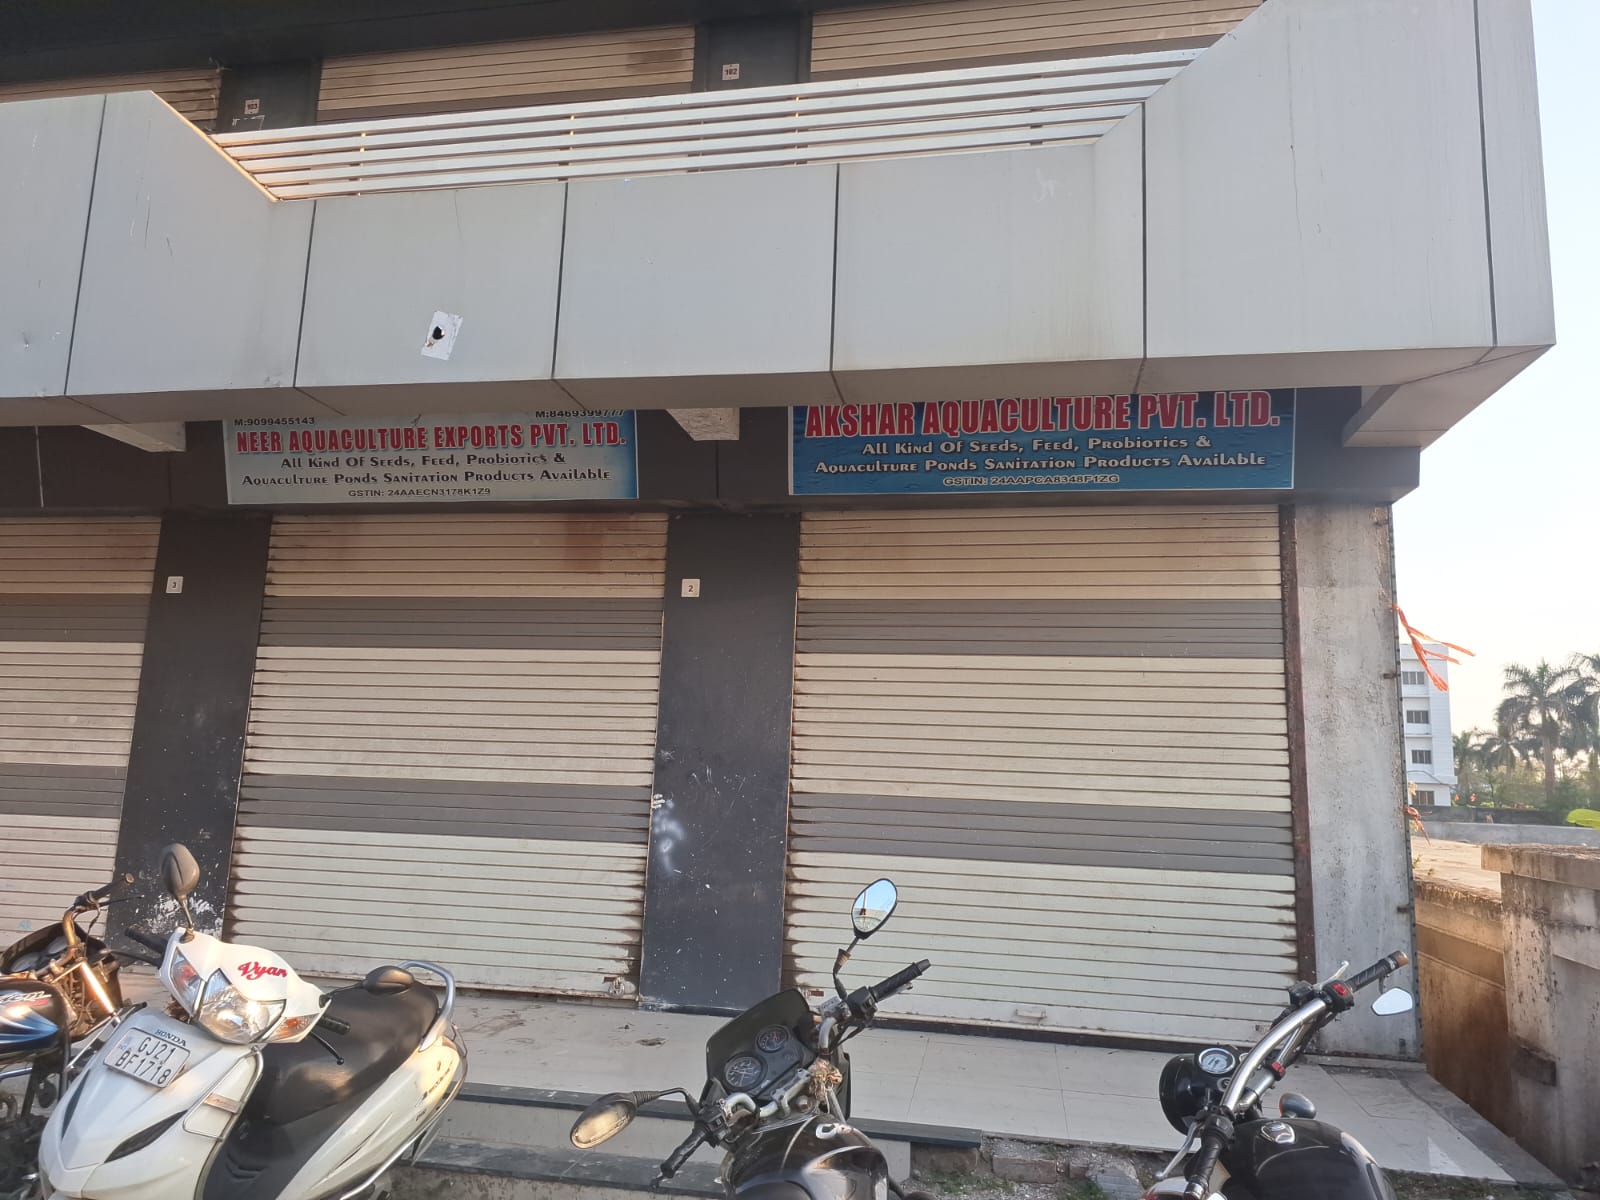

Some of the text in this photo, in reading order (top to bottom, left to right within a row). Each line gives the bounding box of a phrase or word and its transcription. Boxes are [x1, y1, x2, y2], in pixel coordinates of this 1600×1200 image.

[805, 390, 1281, 437] AKSHAR AQUACULTURE PVT. LTD.
[237, 421, 628, 454] NEER AQUACULTURE EXPORTS PVT. LTD.
[862, 435, 1212, 455] All Kind Of Seeds, Feed, Probiotics &
[281, 453, 567, 468] All Kind Of Seeds, Feed, Probiotics &
[815, 453, 1267, 474] Aquaculture Ponds Sanitation Products Available
[242, 469, 612, 487] Aquaculture Ponds Sanitation Products Available
[943, 476, 988, 486] GSTIN:
[348, 489, 385, 497] GSTIN:
[687, 584, 694, 593] 2
[237, 961, 288, 980] Vyan
[154, 1029, 187, 1047] HONDA
[137, 1036, 177, 1064] GJ21
[115, 1050, 172, 1085] BF1718
